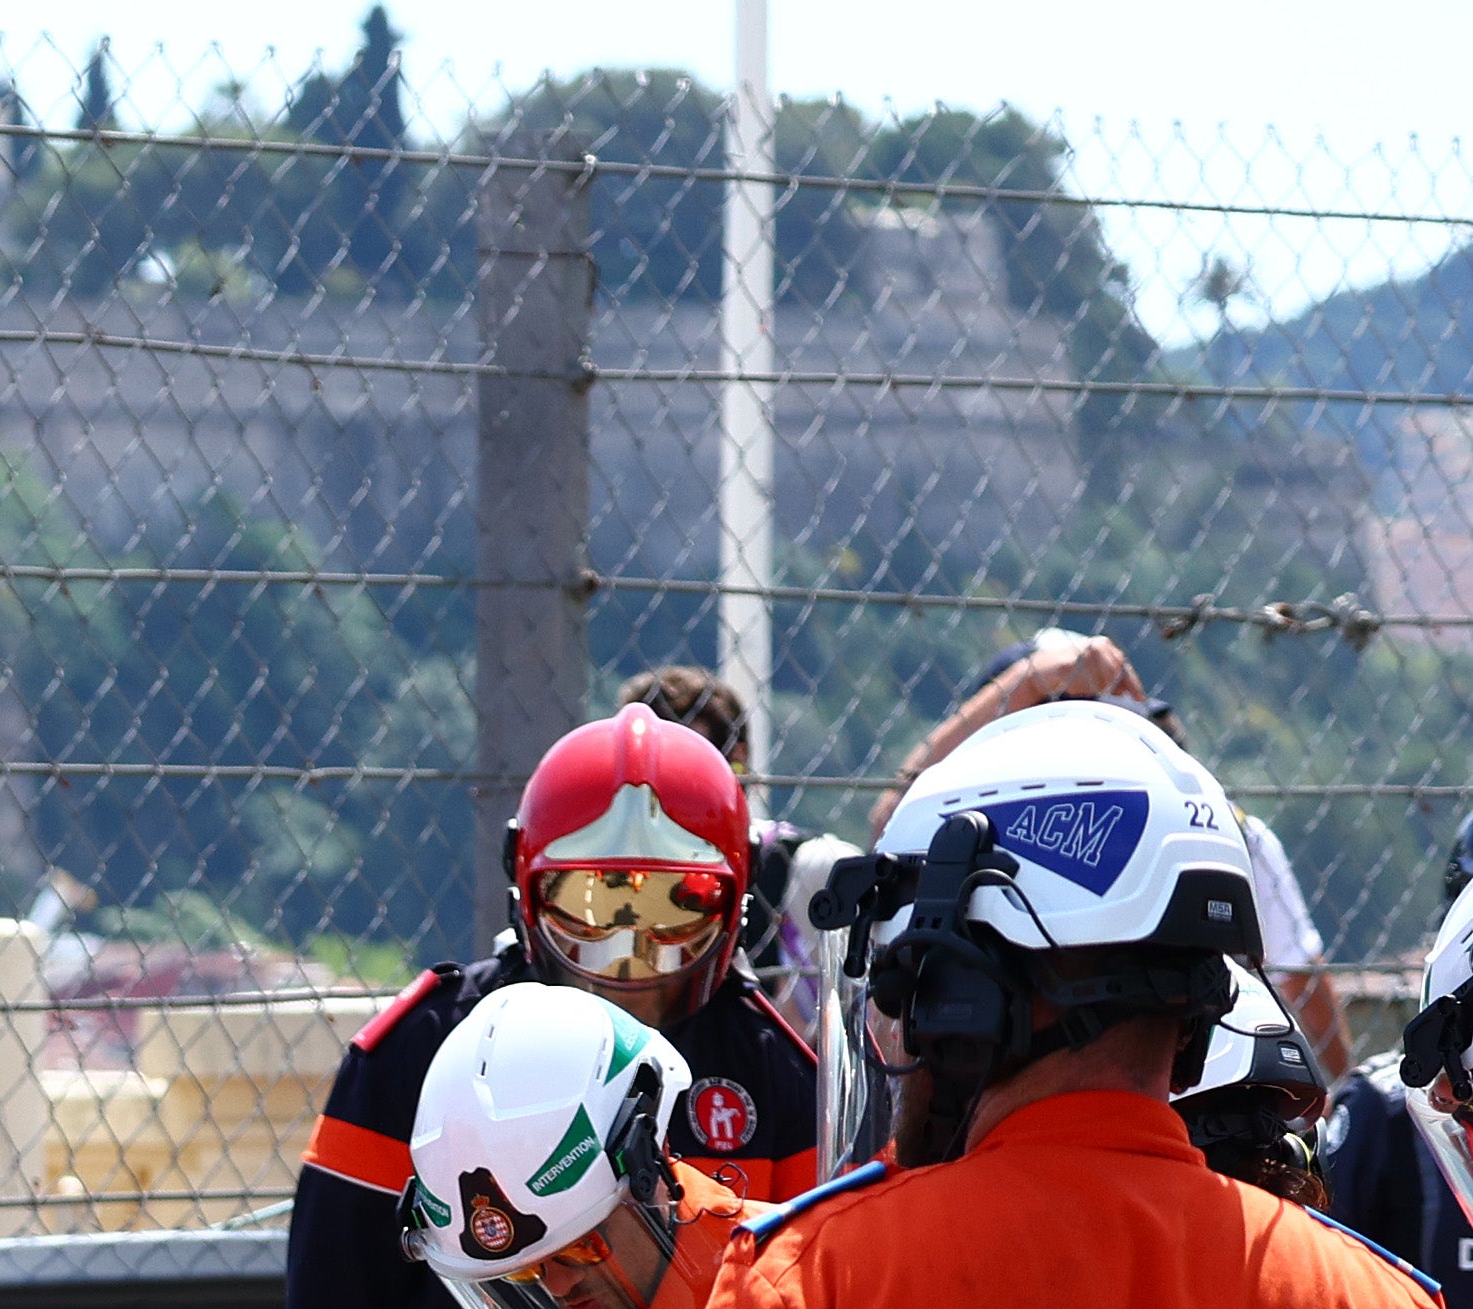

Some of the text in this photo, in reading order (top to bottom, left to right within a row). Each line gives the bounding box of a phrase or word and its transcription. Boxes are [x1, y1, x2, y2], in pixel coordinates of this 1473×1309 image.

[1006, 802, 1124, 867] ACM
[1184, 801, 1219, 831] 22
[1209, 901, 1231, 914] MSA
[531, 1135, 595, 1193] INTERVENTION
